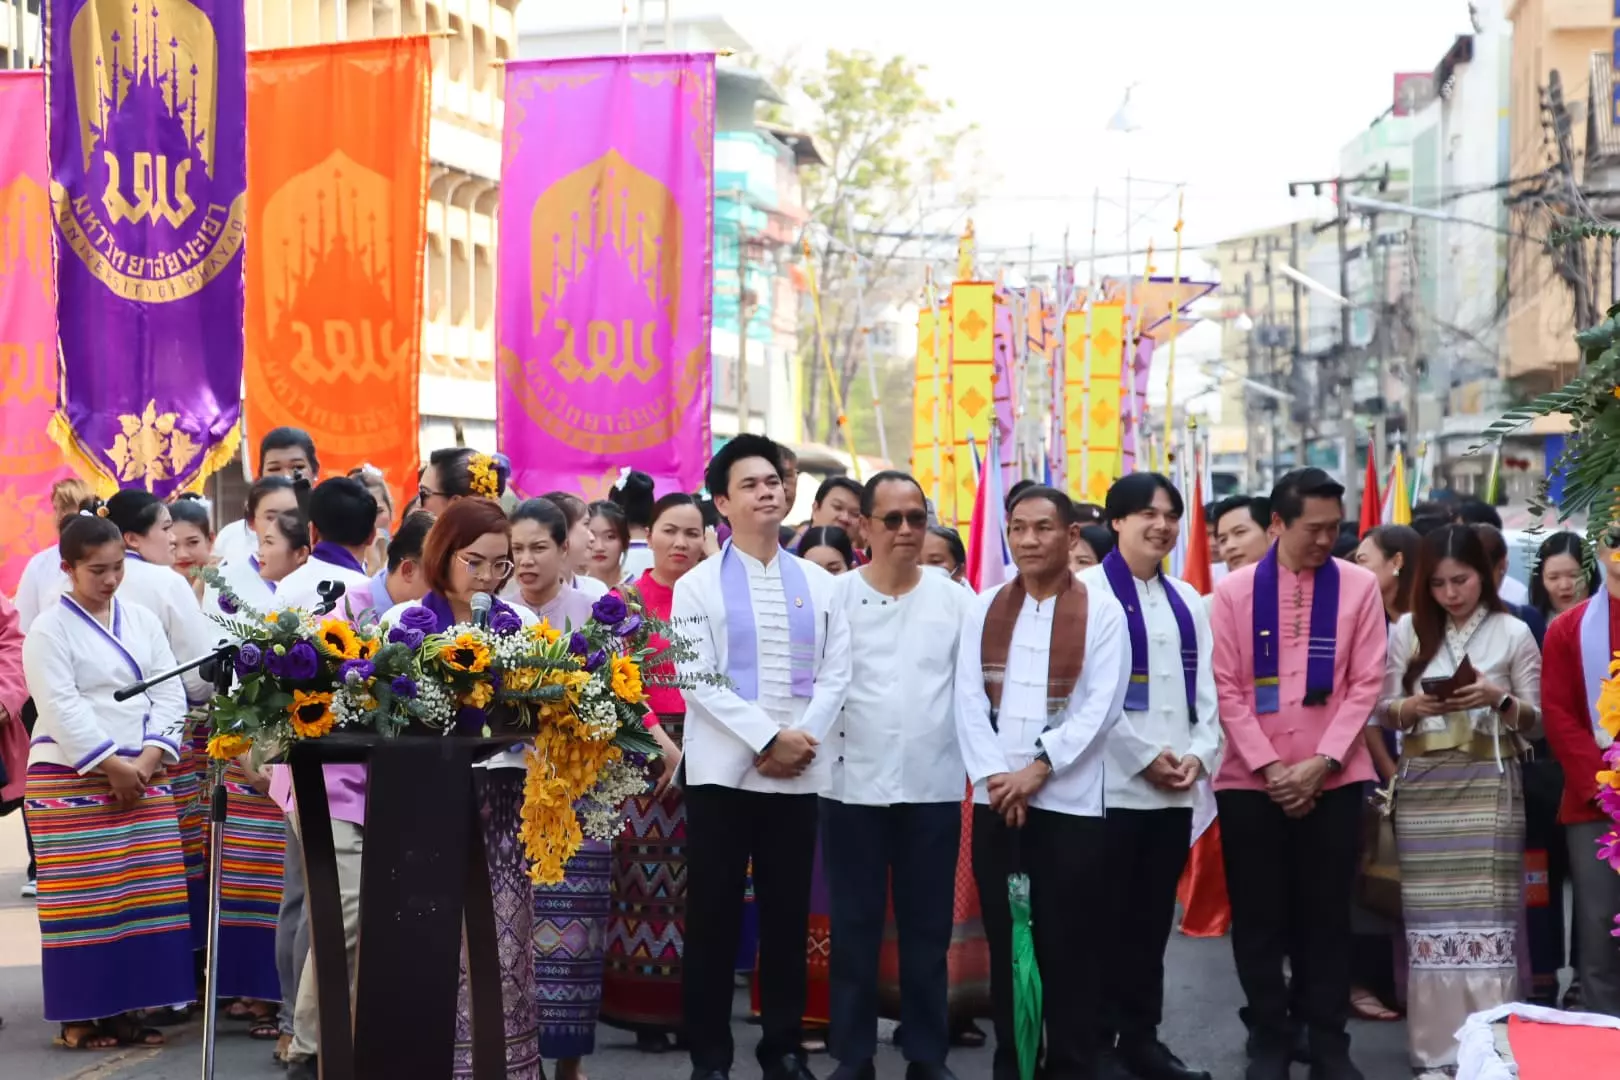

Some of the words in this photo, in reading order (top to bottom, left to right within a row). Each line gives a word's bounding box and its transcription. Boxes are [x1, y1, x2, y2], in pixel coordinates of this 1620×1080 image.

[72, 194, 227, 279] มหาวิทยาลัยพะเยา
